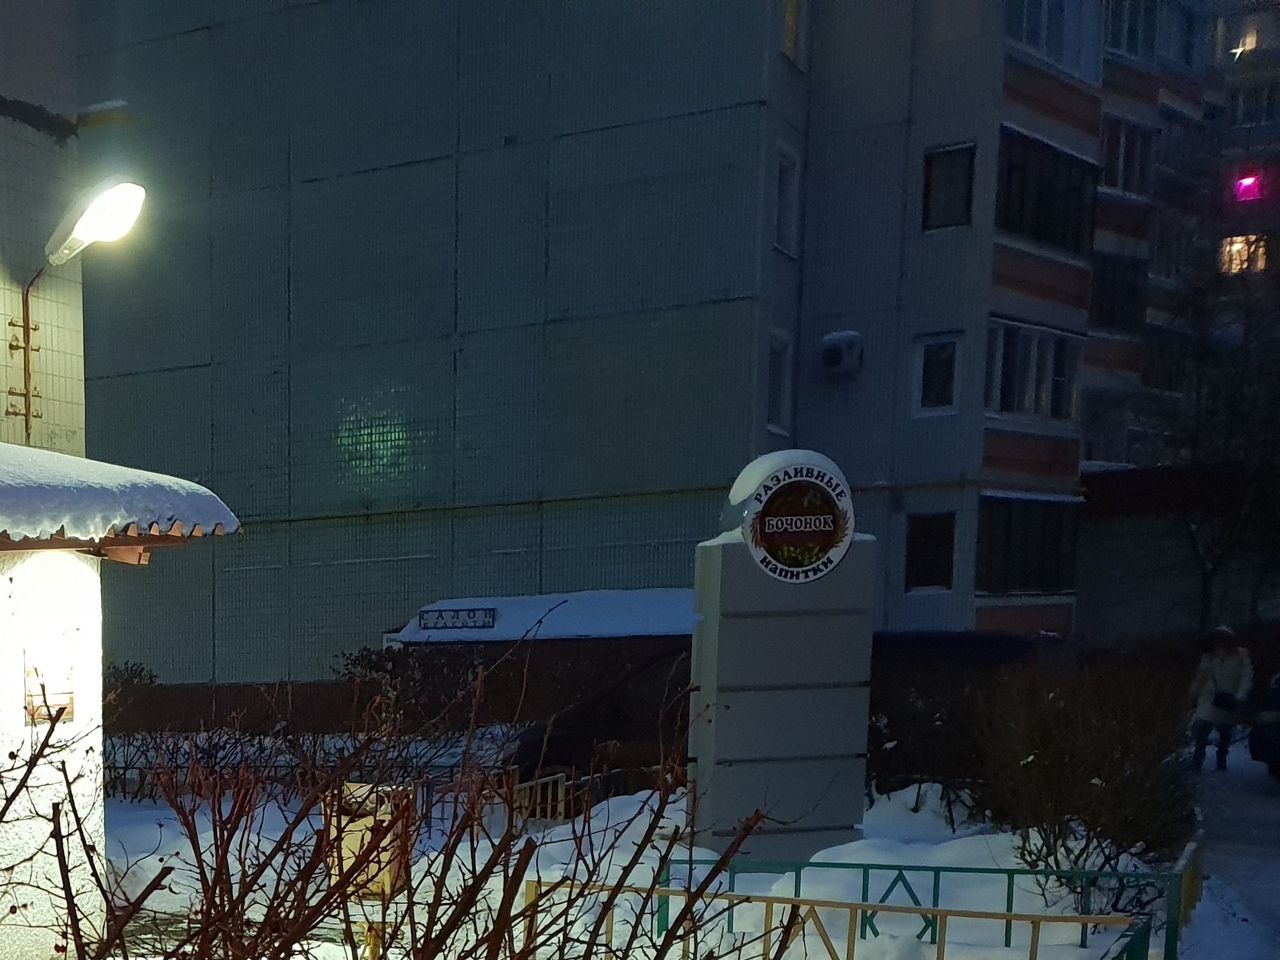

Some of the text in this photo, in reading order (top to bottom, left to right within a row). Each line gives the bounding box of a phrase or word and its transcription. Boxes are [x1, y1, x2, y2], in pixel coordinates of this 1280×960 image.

[754, 467, 847, 503] РАЗЛИВНЫЕ
[765, 515, 833, 532] БОЧОНОК
[422, 610, 492, 621] САЛОН
